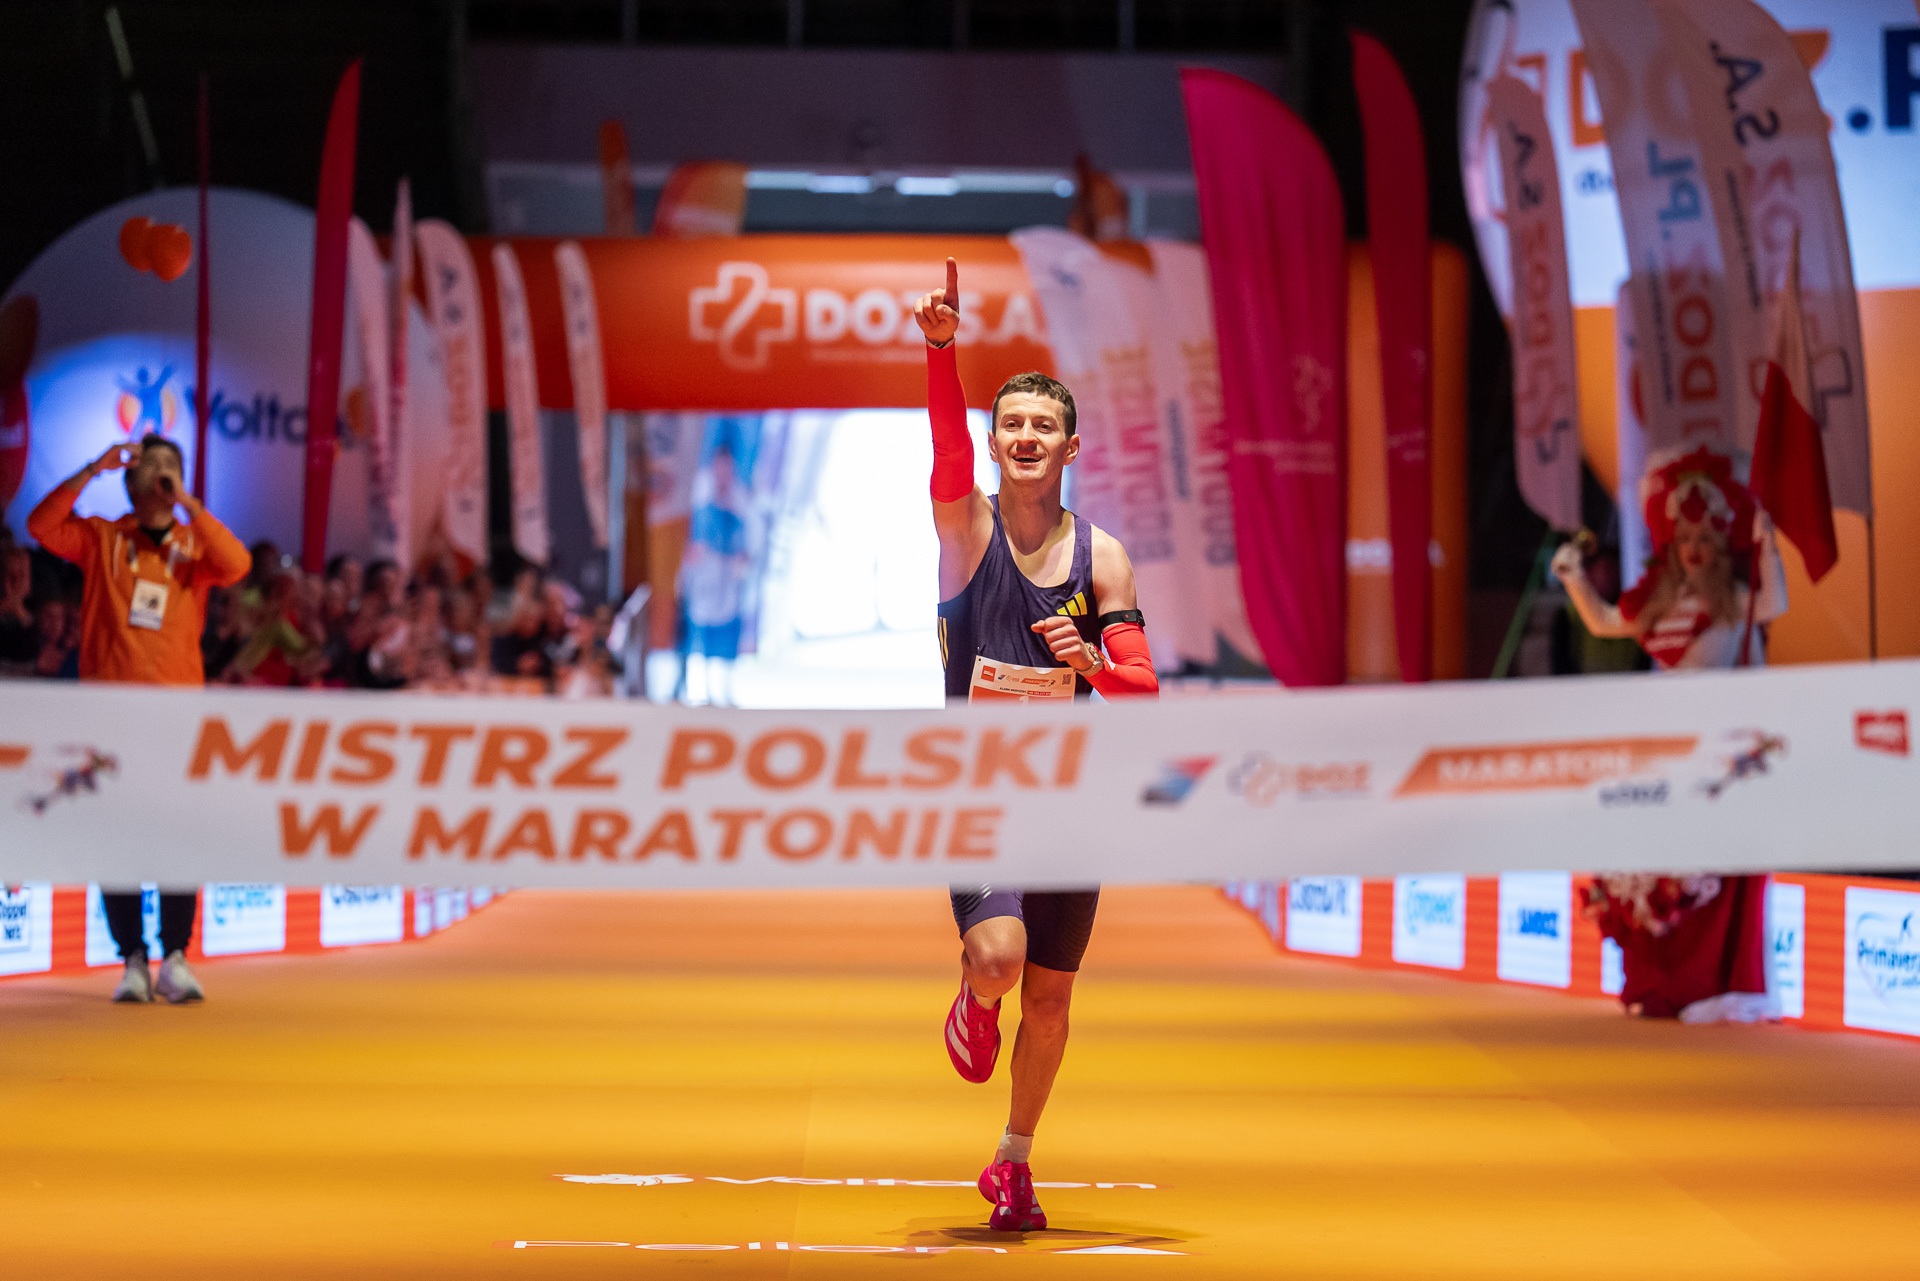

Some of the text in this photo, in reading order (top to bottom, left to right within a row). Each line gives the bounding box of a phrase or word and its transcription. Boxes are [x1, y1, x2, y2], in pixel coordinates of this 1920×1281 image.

[187, 717, 1091, 792] MISTRZ POLSKI
[278, 804, 1005, 863] W MARATONIE
[704, 1176, 1156, 1188] Voltaen
